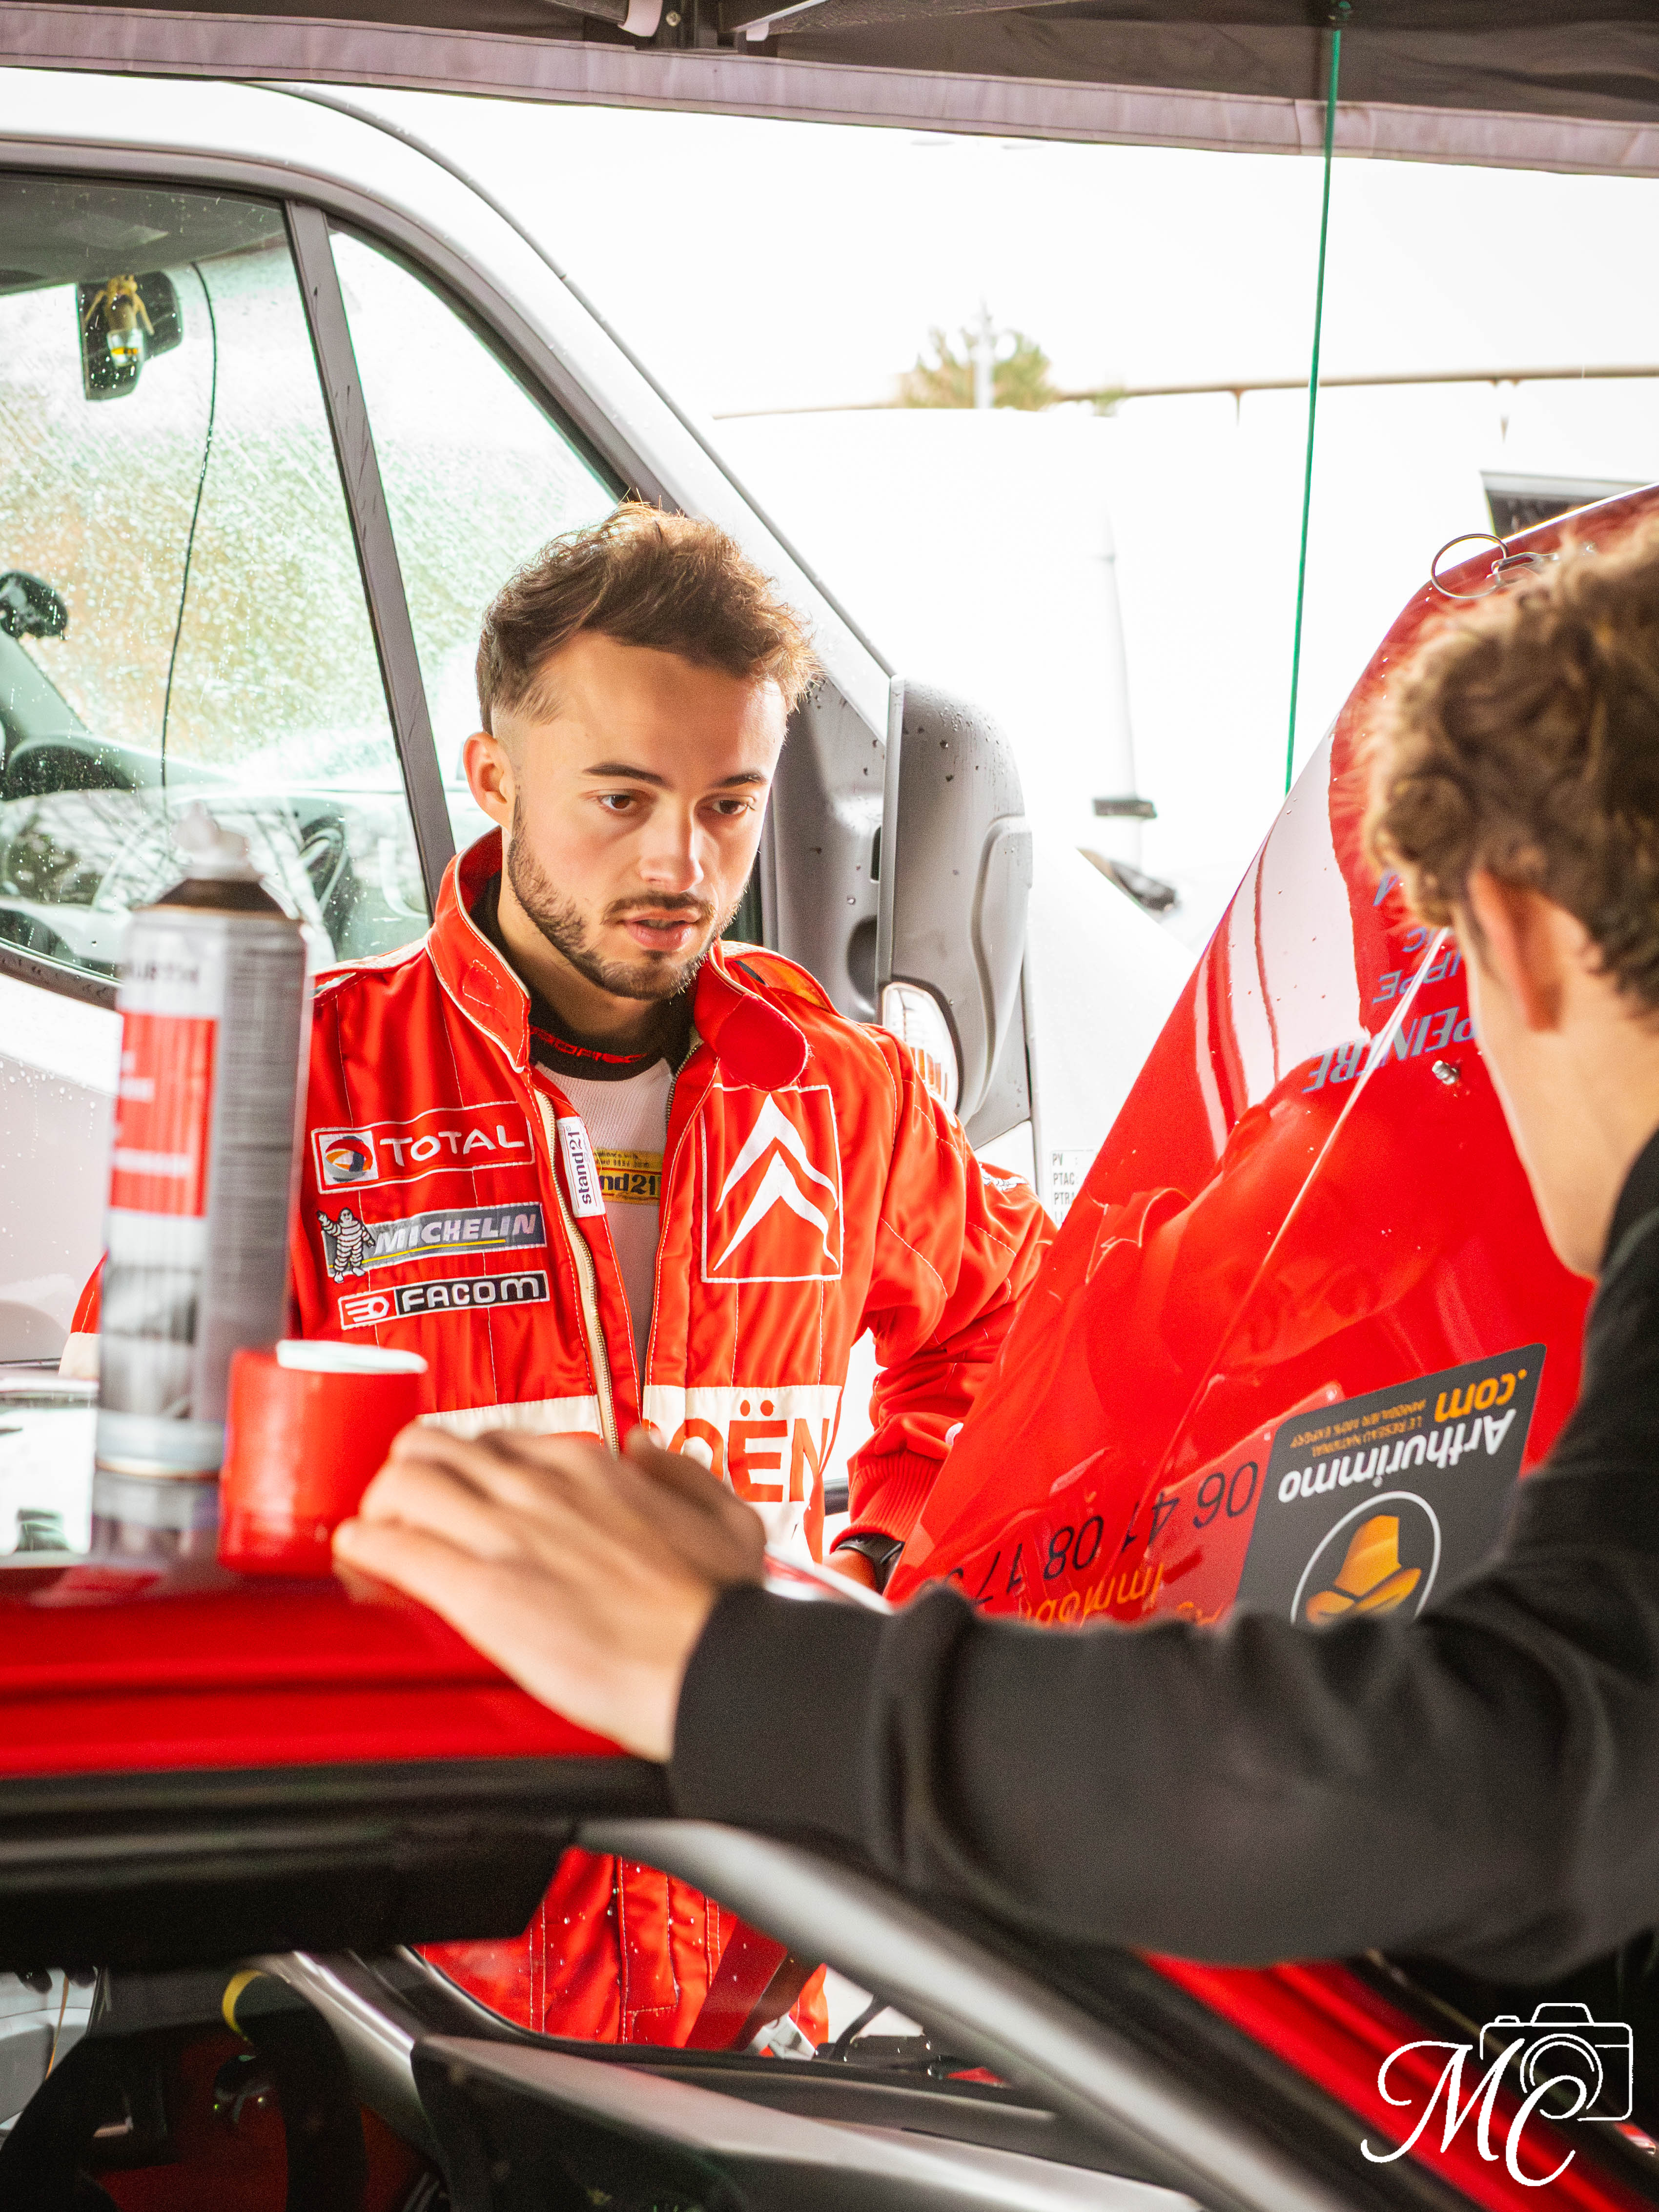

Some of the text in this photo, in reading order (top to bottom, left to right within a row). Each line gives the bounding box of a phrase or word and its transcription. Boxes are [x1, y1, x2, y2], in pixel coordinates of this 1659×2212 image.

[380, 1125, 525, 1167] TOTAL
[568, 1131, 592, 1205] stand21
[1052, 1153, 1063, 1166] PV
[599, 1173, 656, 1196] nd21
[374, 1213, 537, 1256] MICHELIN
[401, 1277, 539, 1312] FACOM
[1434, 1369, 1527, 1422] .com
[1278, 1409, 1517, 1503] Arthurimmo
[1192, 1461, 1258, 1529] 06
[1044, 1515, 1104, 1580] 08
